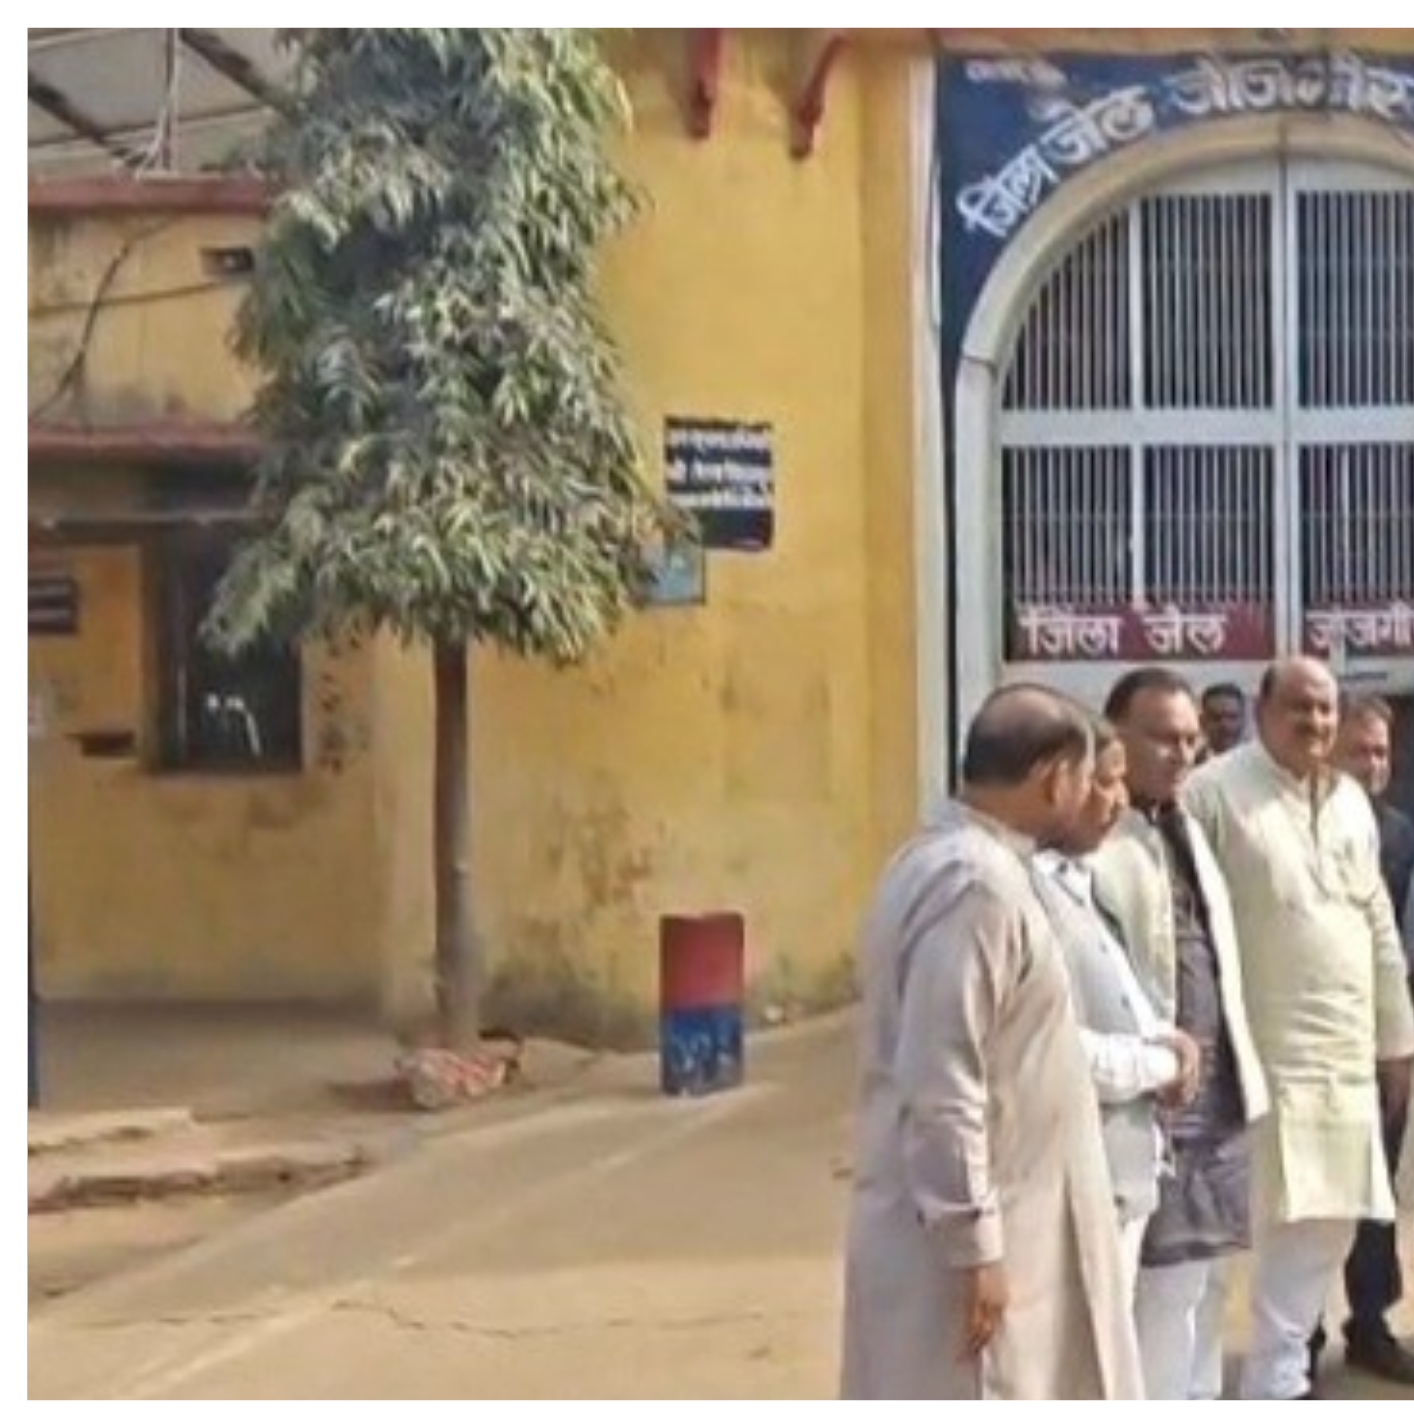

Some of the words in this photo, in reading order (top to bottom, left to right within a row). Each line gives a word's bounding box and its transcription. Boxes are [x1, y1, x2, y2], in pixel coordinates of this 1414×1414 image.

[956, 144, 1058, 238] जिला
[1028, 85, 1155, 165] जेल
[1017, 604, 1122, 655] जिला
[1143, 601, 1228, 655] जेल
